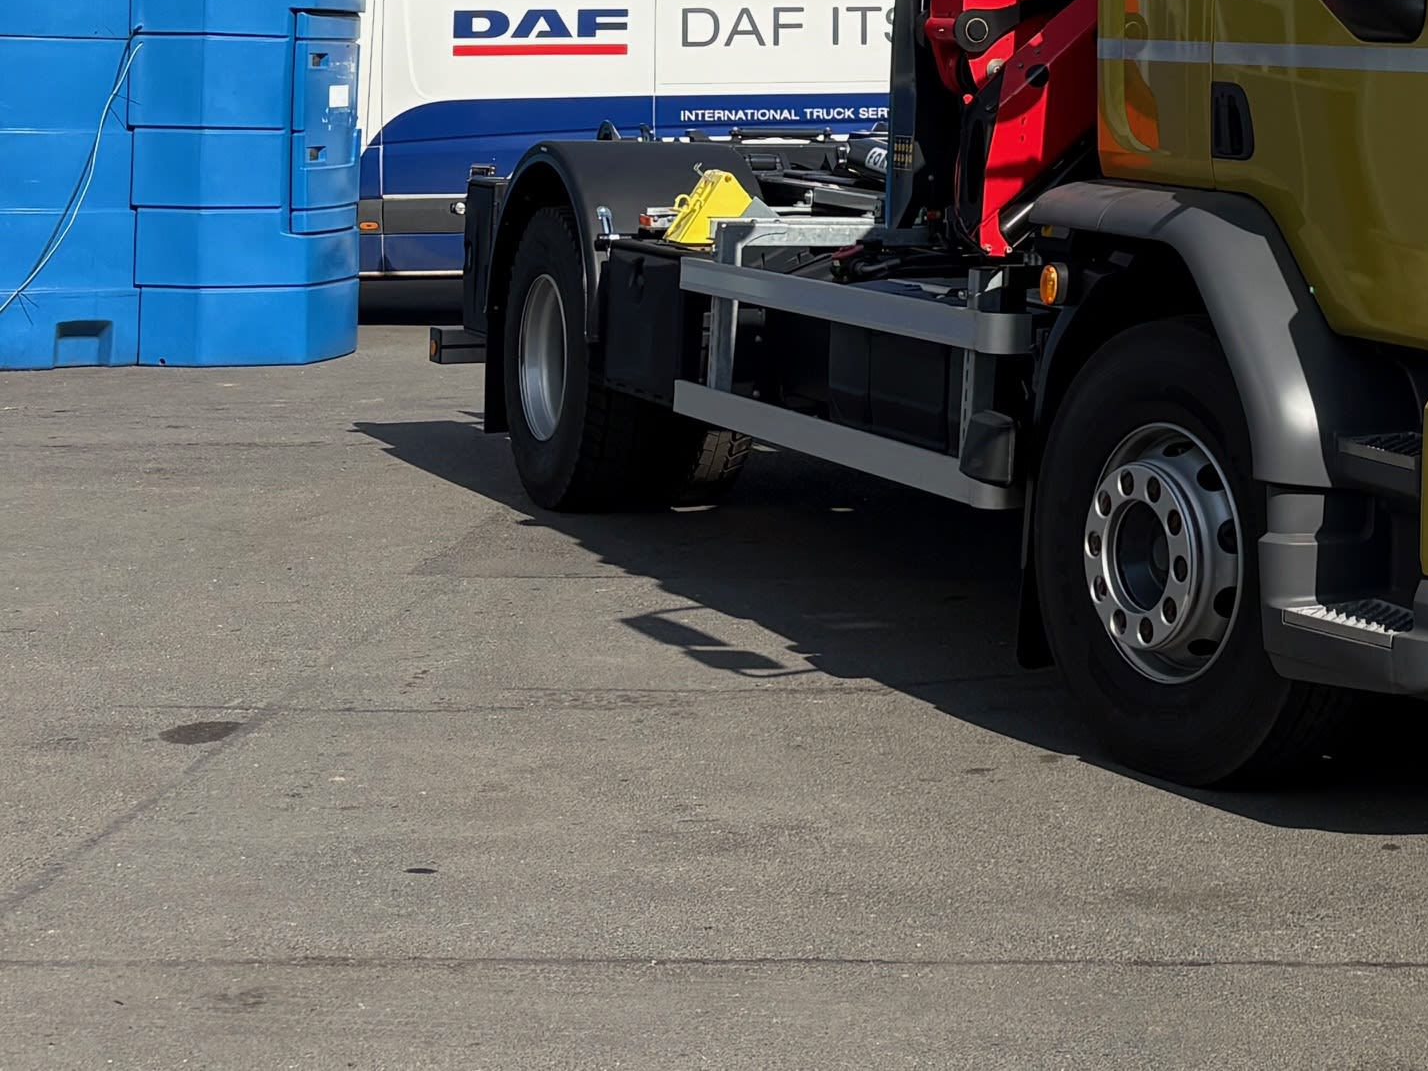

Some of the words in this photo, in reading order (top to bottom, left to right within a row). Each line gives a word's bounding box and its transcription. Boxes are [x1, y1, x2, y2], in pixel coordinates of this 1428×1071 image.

[453, 8, 629, 39] DAF
[681, 6, 804, 47] DAF
[680, 109, 800, 121] INTERNATIONAL
[803, 108, 855, 120] TRUCK
[858, 107, 890, 119] SER
